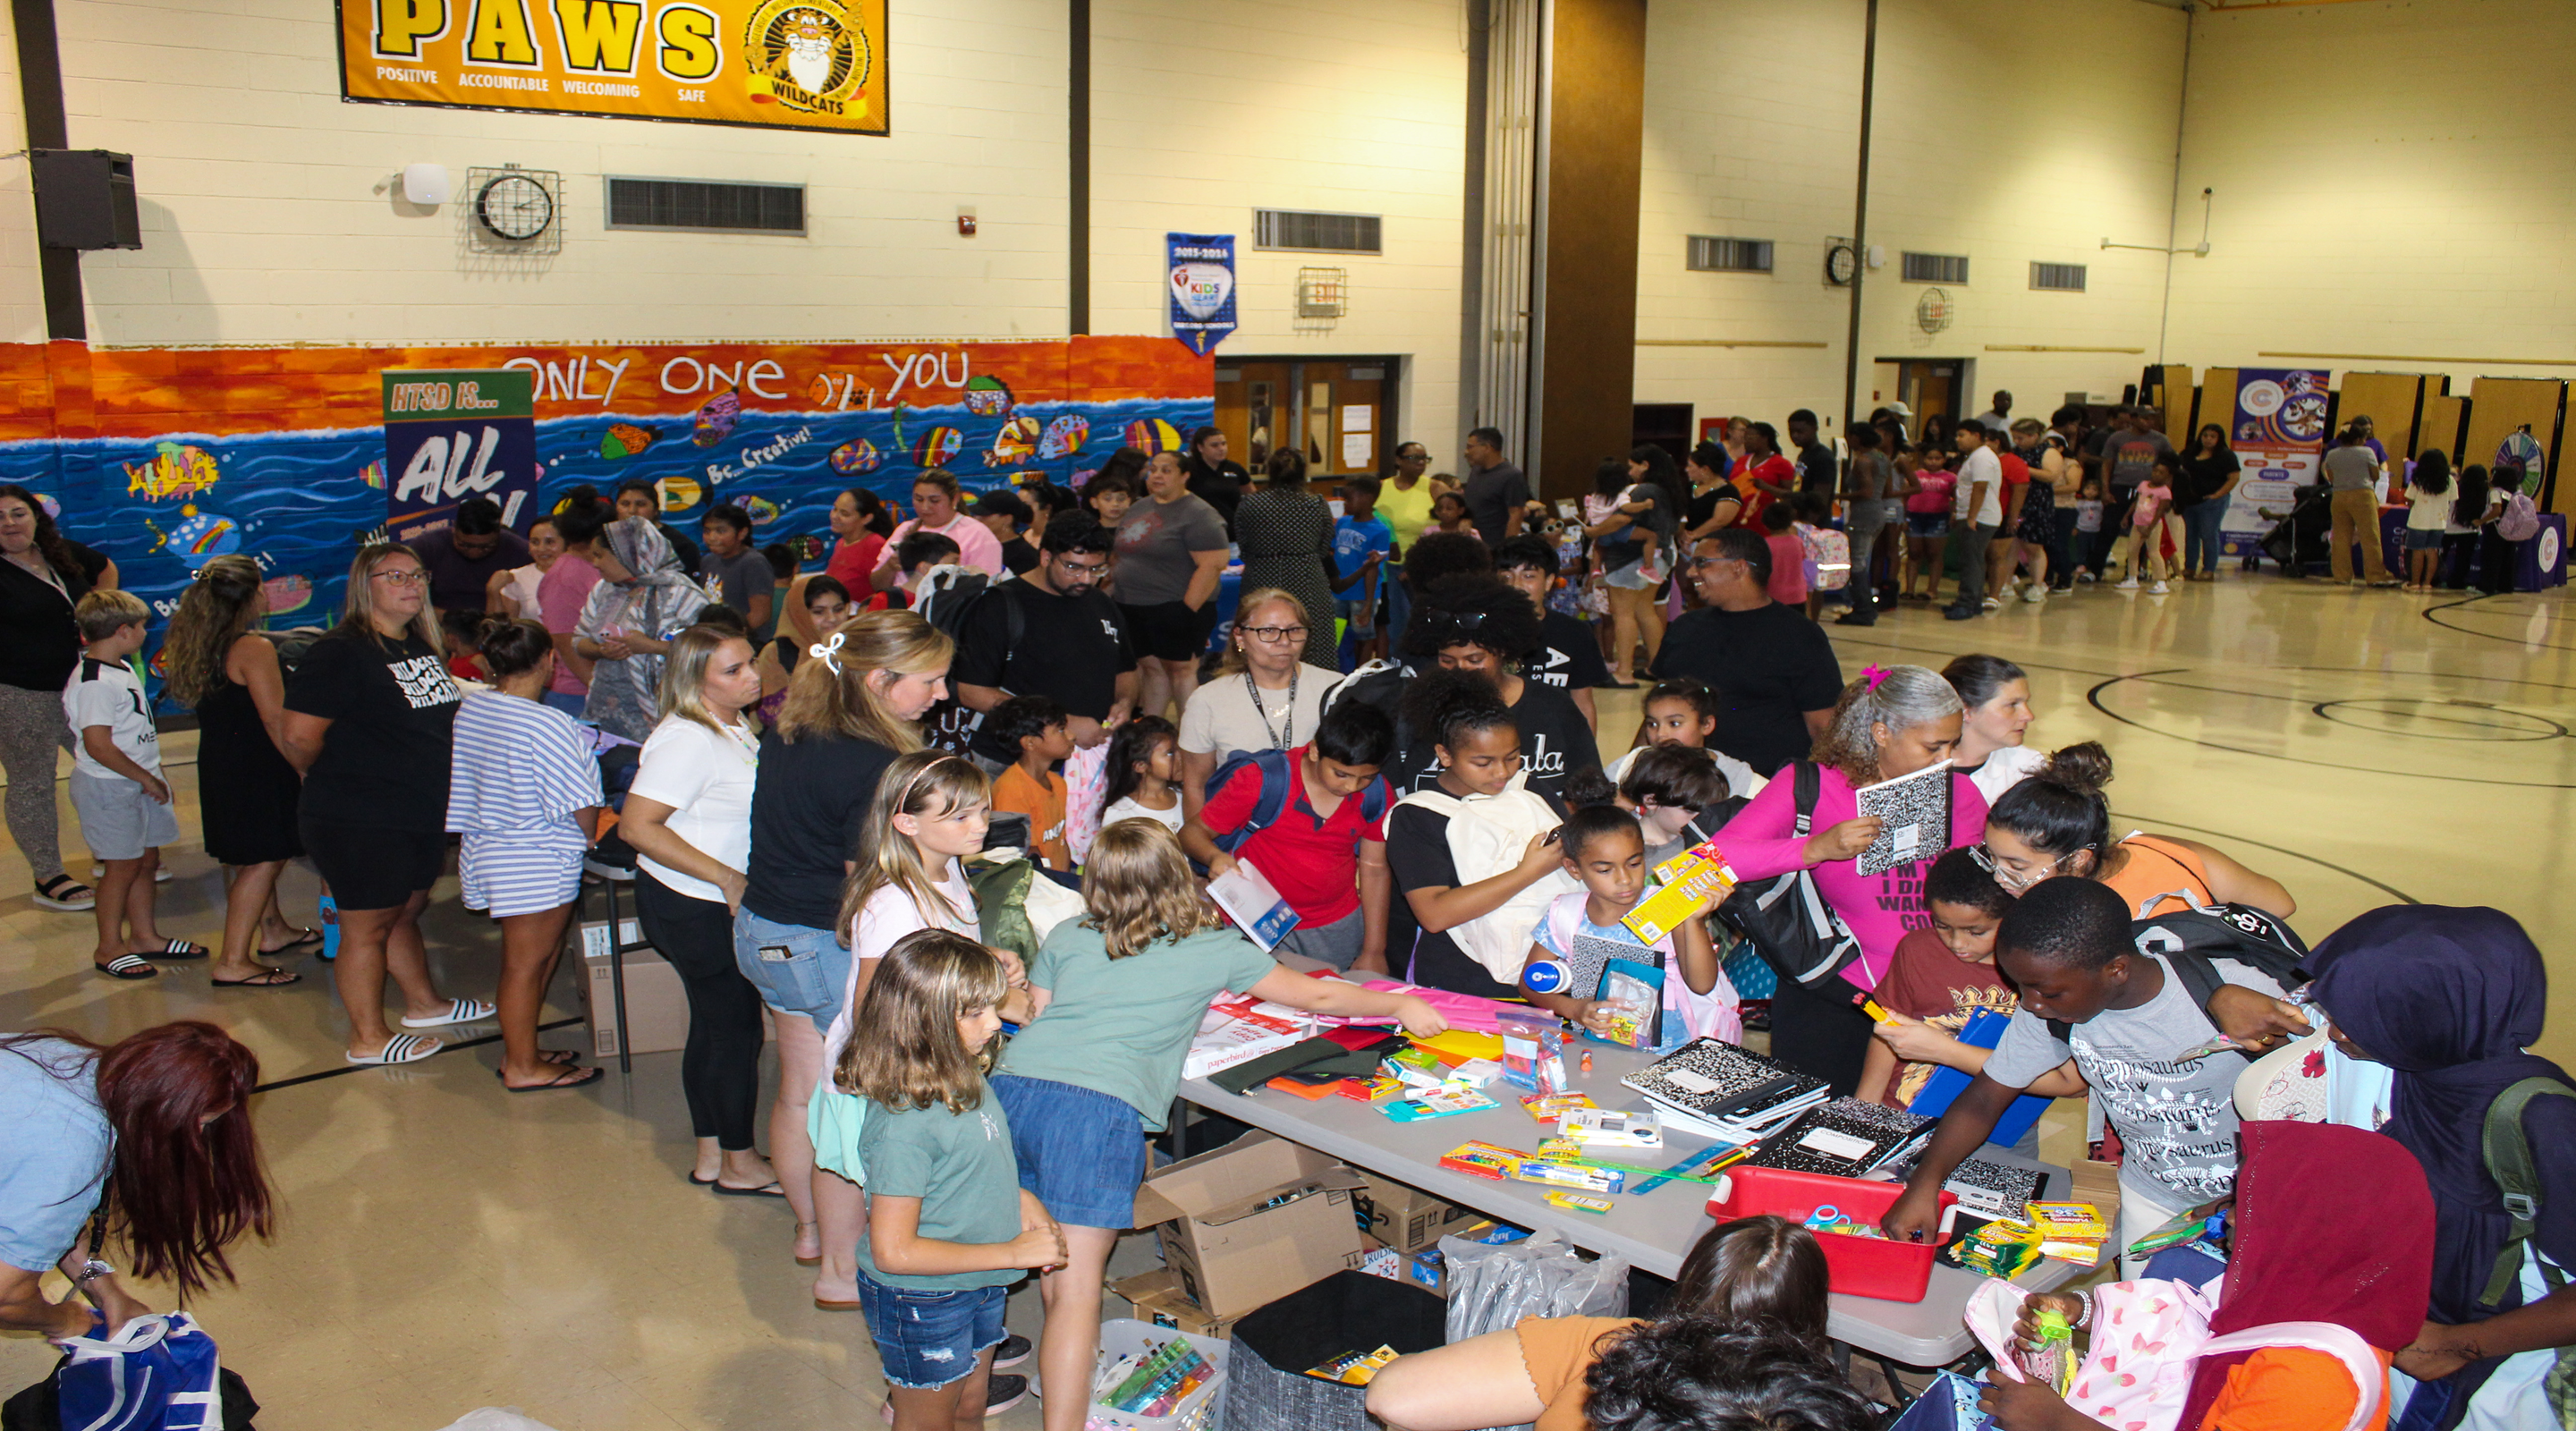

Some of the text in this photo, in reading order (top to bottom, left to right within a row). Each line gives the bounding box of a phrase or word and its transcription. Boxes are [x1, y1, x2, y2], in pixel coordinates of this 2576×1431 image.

[370, 0, 723, 84] PAWS
[377, 66, 438, 84] POSITIVE
[458, 73, 549, 92] ACCOUNTABLE
[563, 80, 640, 97] WELCOMING
[677, 89, 707, 103] SAFE
[771, 80, 843, 114] WILDCATS
[1191, 283, 1220, 294] KIDS
[501, 355, 630, 405] ONLY
[883, 351, 969, 401] YOU
[391, 381, 498, 411] HTSD IS...
[741, 425, 813, 470] Creative!
[394, 426, 504, 504] ALL
[1899, 880, 1923, 893] DI
[1876, 896, 1928, 911] WAN
[1900, 914, 1930, 930] CO
[1208, 1050, 1247, 1070] paperbird
[1819, 1129, 1870, 1147] COMPOSITION
[1488, 1230, 1513, 1244] July
[1980, 1229, 2015, 1243] CRAYONS
